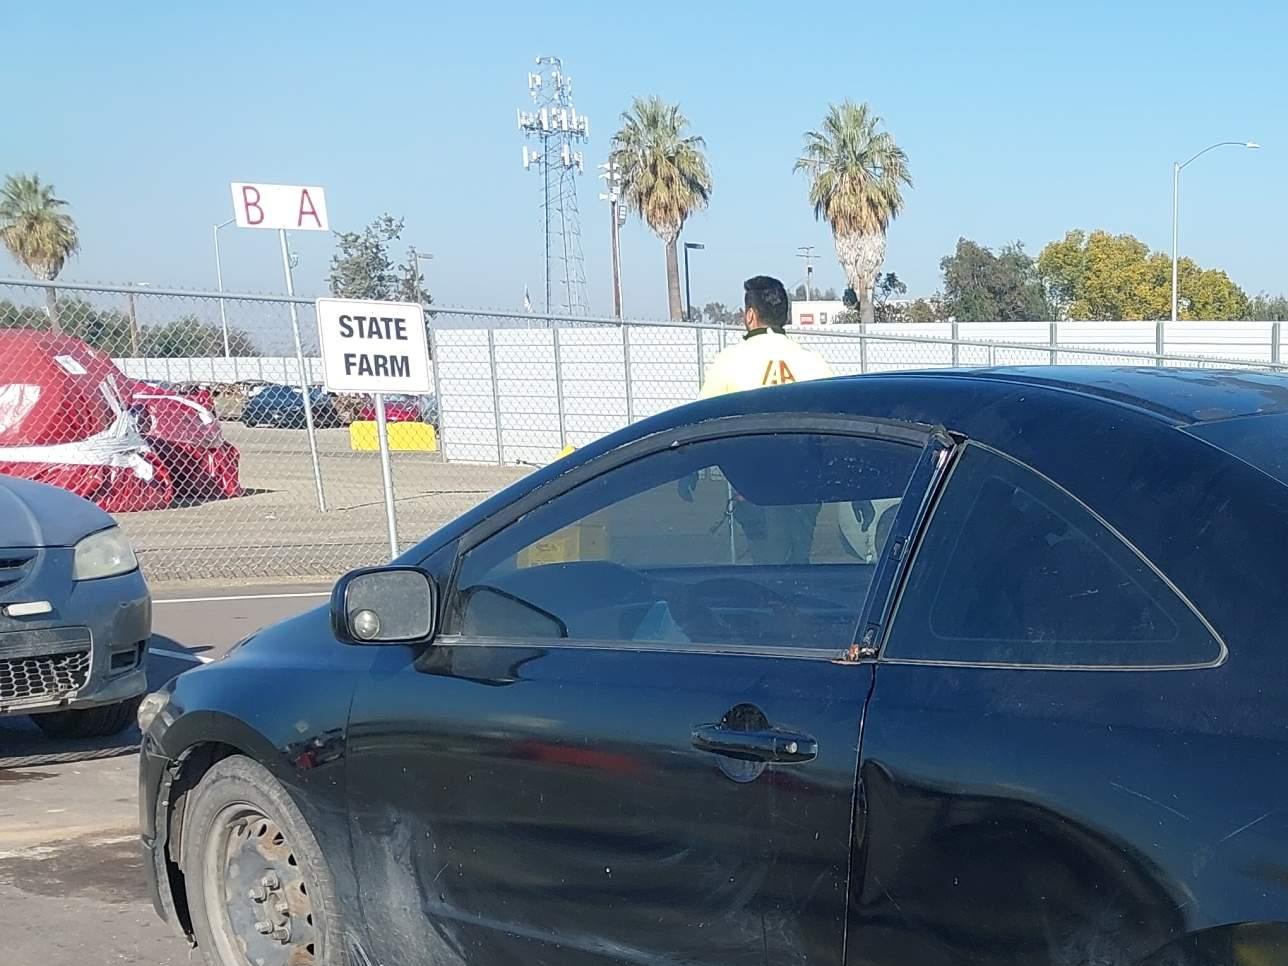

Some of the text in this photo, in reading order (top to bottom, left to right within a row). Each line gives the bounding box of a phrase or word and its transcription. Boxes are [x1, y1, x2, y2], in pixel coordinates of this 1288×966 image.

[241, 185, 322, 228] B A
[338, 314, 408, 341] STATE
[343, 353, 411, 378] FARM
